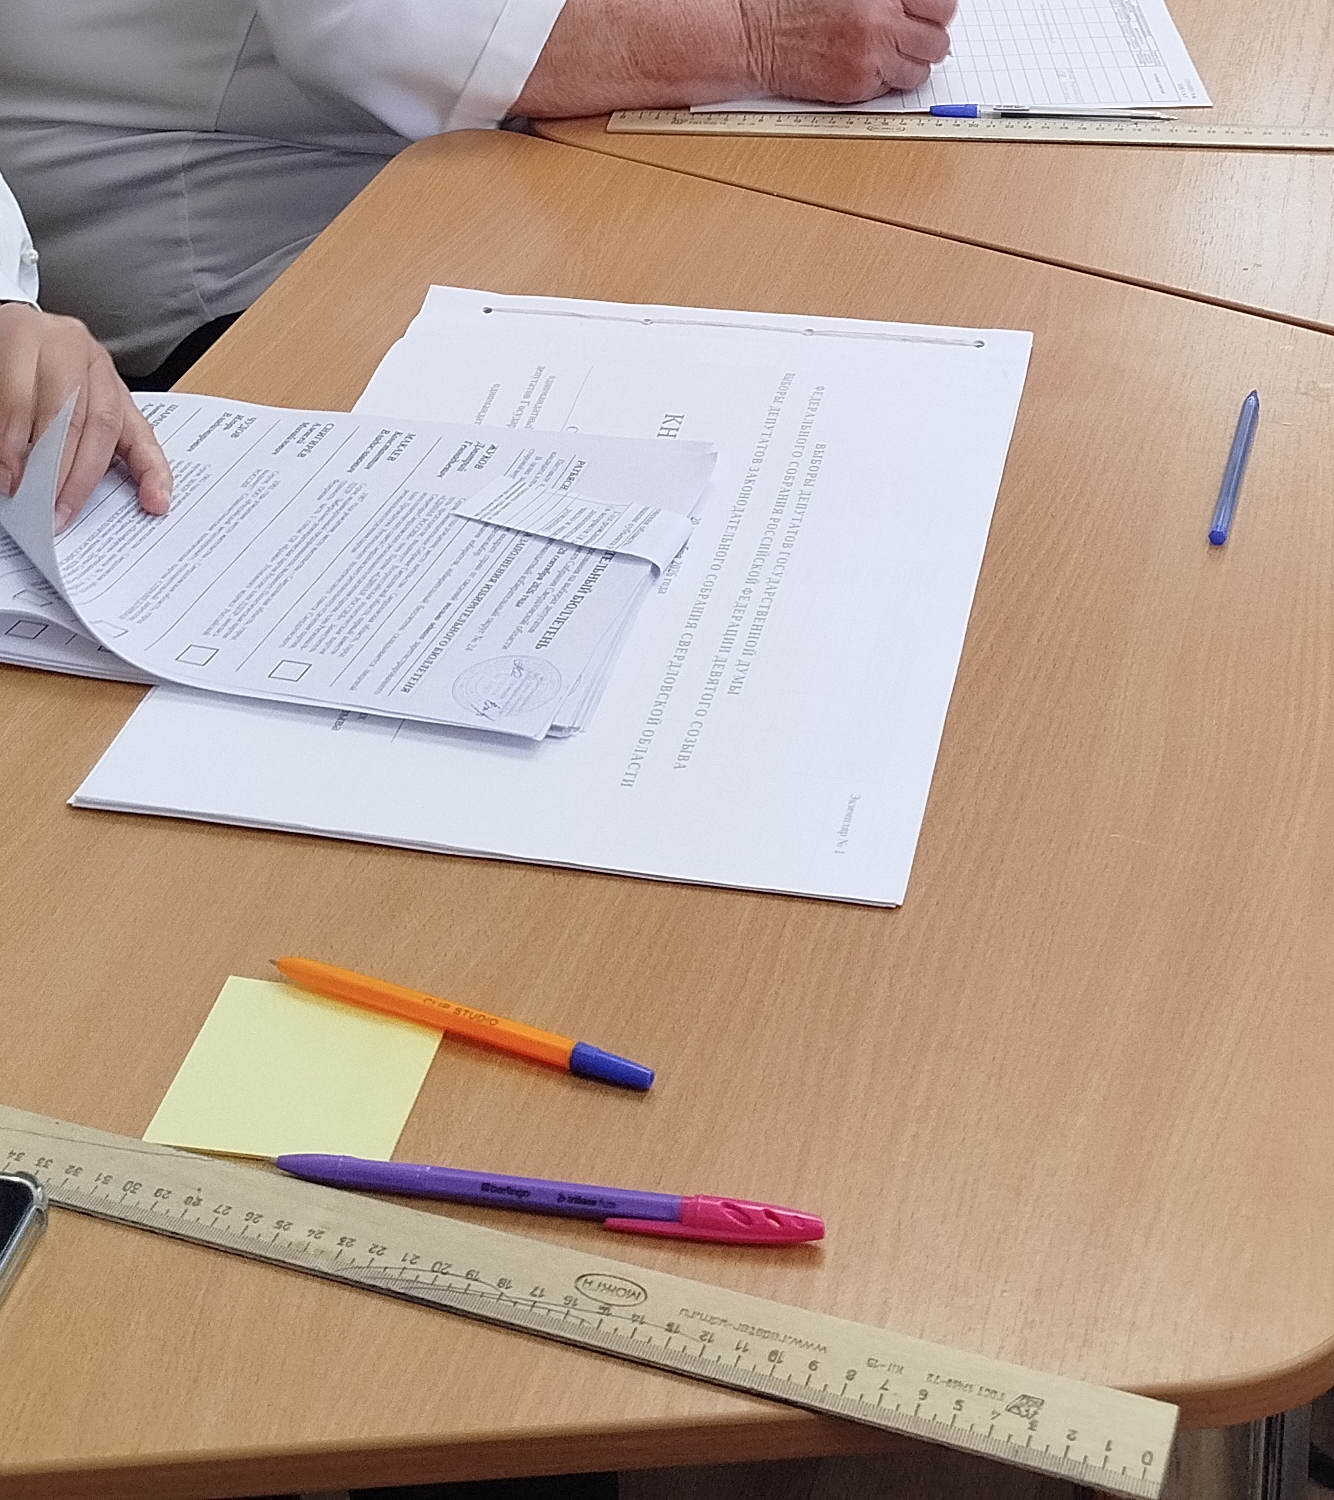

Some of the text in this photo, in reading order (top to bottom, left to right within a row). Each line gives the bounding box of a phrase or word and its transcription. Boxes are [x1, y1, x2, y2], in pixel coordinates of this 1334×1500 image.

[473, 383, 502, 426] одномандат
[386, 433, 417, 462] МАКАЕВ
[473, 444, 499, 470] ЖУКОВ
[559, 460, 586, 490] РАЗЪЯСН
[485, 539, 531, 583] ЗАПОЛНЕНИЯ
[533, 555, 563, 580] сентября
[577, 550, 616, 594] ТЕЛЬНЫЙ
[727, 443, 827, 695] ВЫБОРЫ ДЕПУТАТОВ ГОСУДАРСТВЕННОЙ ДУМЫ
[620, 372, 796, 787] ВЫБОРЫ ДЕПУТАТОВ ЗАКОНОДАТЕЛЬНОГО СОБРАНИЯ СВЕРДЛОВСКОЙ ОБЛАСТИ
[673, 385, 825, 770] ФЕДЕРАЛЬНОГО СОБРАНИЯ РОССИЙСКОЙ ФЕДЕРАЦИИ ДЕВЯТОГО СОЗЫВА
[657, 578, 674, 595] года
[435, 584, 495, 645] ИЗБИРАТЕЛЬНОГО
[534, 594, 582, 650] БЮЛЛЕТЕНЬ
[397, 647, 445, 692] БЮЛЛЕТЕНЯ
[453, 1006, 499, 1027] STUDIO
[6, 1149, 26, 1162] 34
[34, 1156, 54, 1169] 33
[64, 1164, 84, 1177] 32
[94, 1171, 114, 1183] 31
[121, 1179, 143, 1194] 30
[152, 1187, 173, 1200] 29
[183, 1195, 203, 1208] 28
[211, 1203, 232, 1216] 27
[243, 1211, 263, 1224] 26
[274, 1219, 294, 1232] 25
[306, 1227, 326, 1240] 24
[338, 1236, 357, 1248] 23
[368, 1243, 388, 1256] 22
[401, 1252, 420, 1265] 21
[431, 1261, 452, 1276] 20
[465, 1269, 480, 1282] 19
[497, 1277, 512, 1291] 18
[530, 1285, 545, 1299] 17
[563, 1295, 578, 1309] 16
[630, 1312, 646, 1326] 14
[700, 1330, 715, 1344] 12
[735, 1340, 750, 1353] 11
[767, 1349, 784, 1365] 10
[807, 1359, 820, 1372] 9
[845, 1368, 857, 1381] 8
[878, 1378, 890, 1391] 7
[918, 1388, 929, 1401] 6
[952, 1399, 964, 1412] 5
[990, 1409, 1001, 1420] 4
[1027, 1419, 1040, 1432] 3
[1065, 1428, 1078, 1442] 2
[1104, 1439, 1113, 1452] 1
[1141, 1450, 1154, 1466] 0
